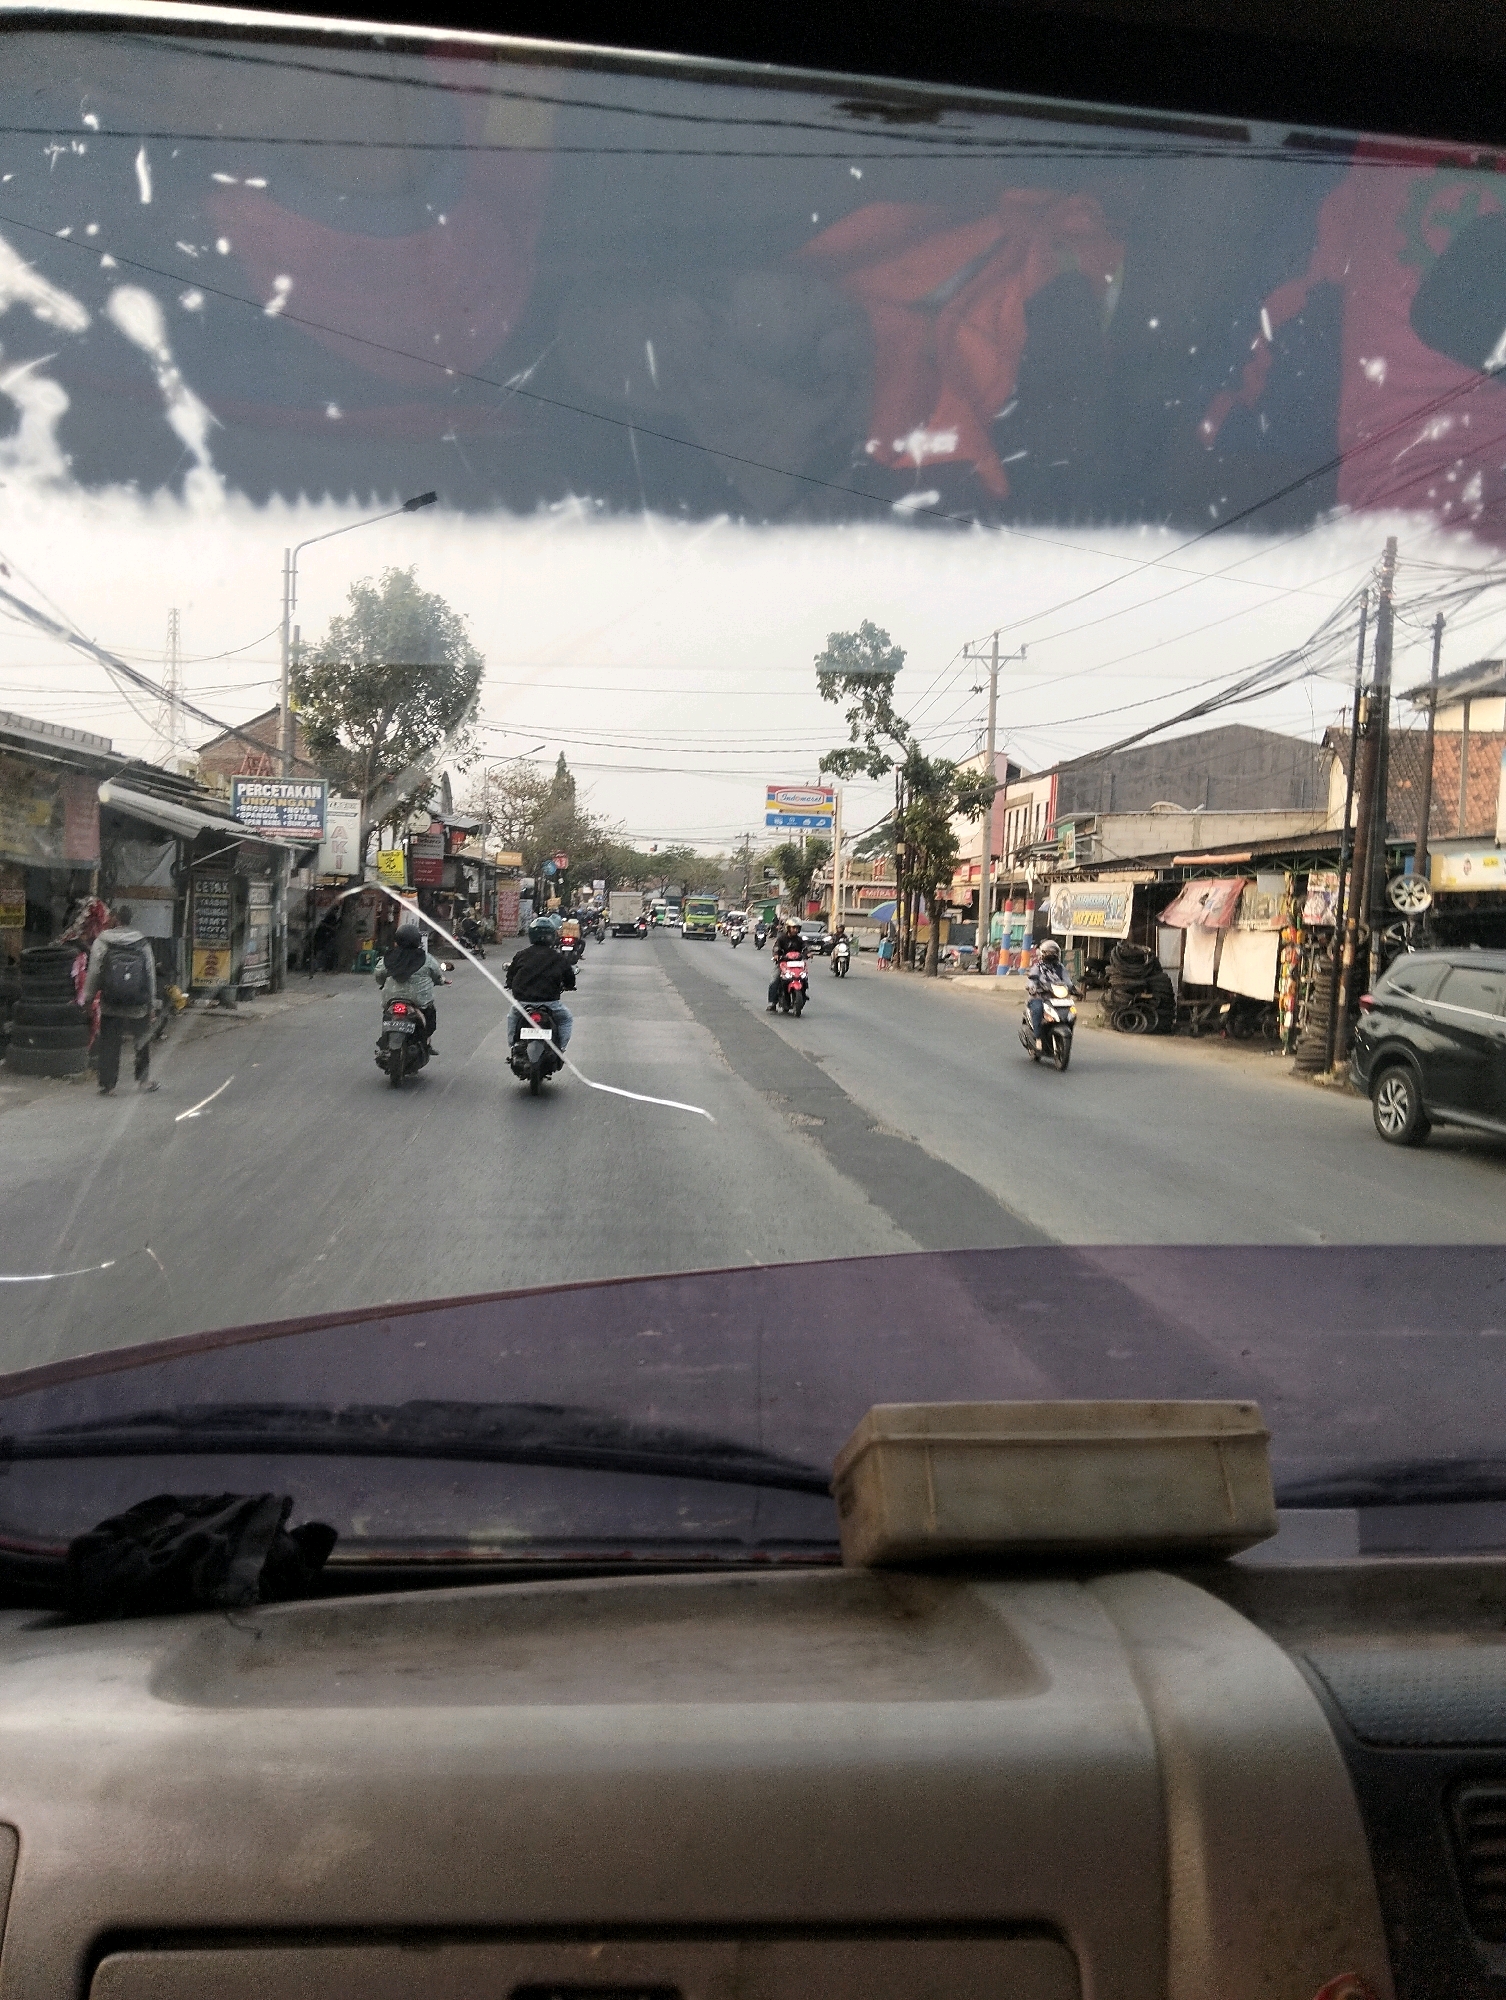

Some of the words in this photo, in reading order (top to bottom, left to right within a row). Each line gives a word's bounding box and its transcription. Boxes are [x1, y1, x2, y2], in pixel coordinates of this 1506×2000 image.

[237, 783, 322, 799] PERCETAKAN
[781, 793, 822, 802] Indomaret
[241, 797, 316, 807] UNDANGAN
[330, 826, 349, 870] AKI
[195, 881, 229, 894] CETAK
